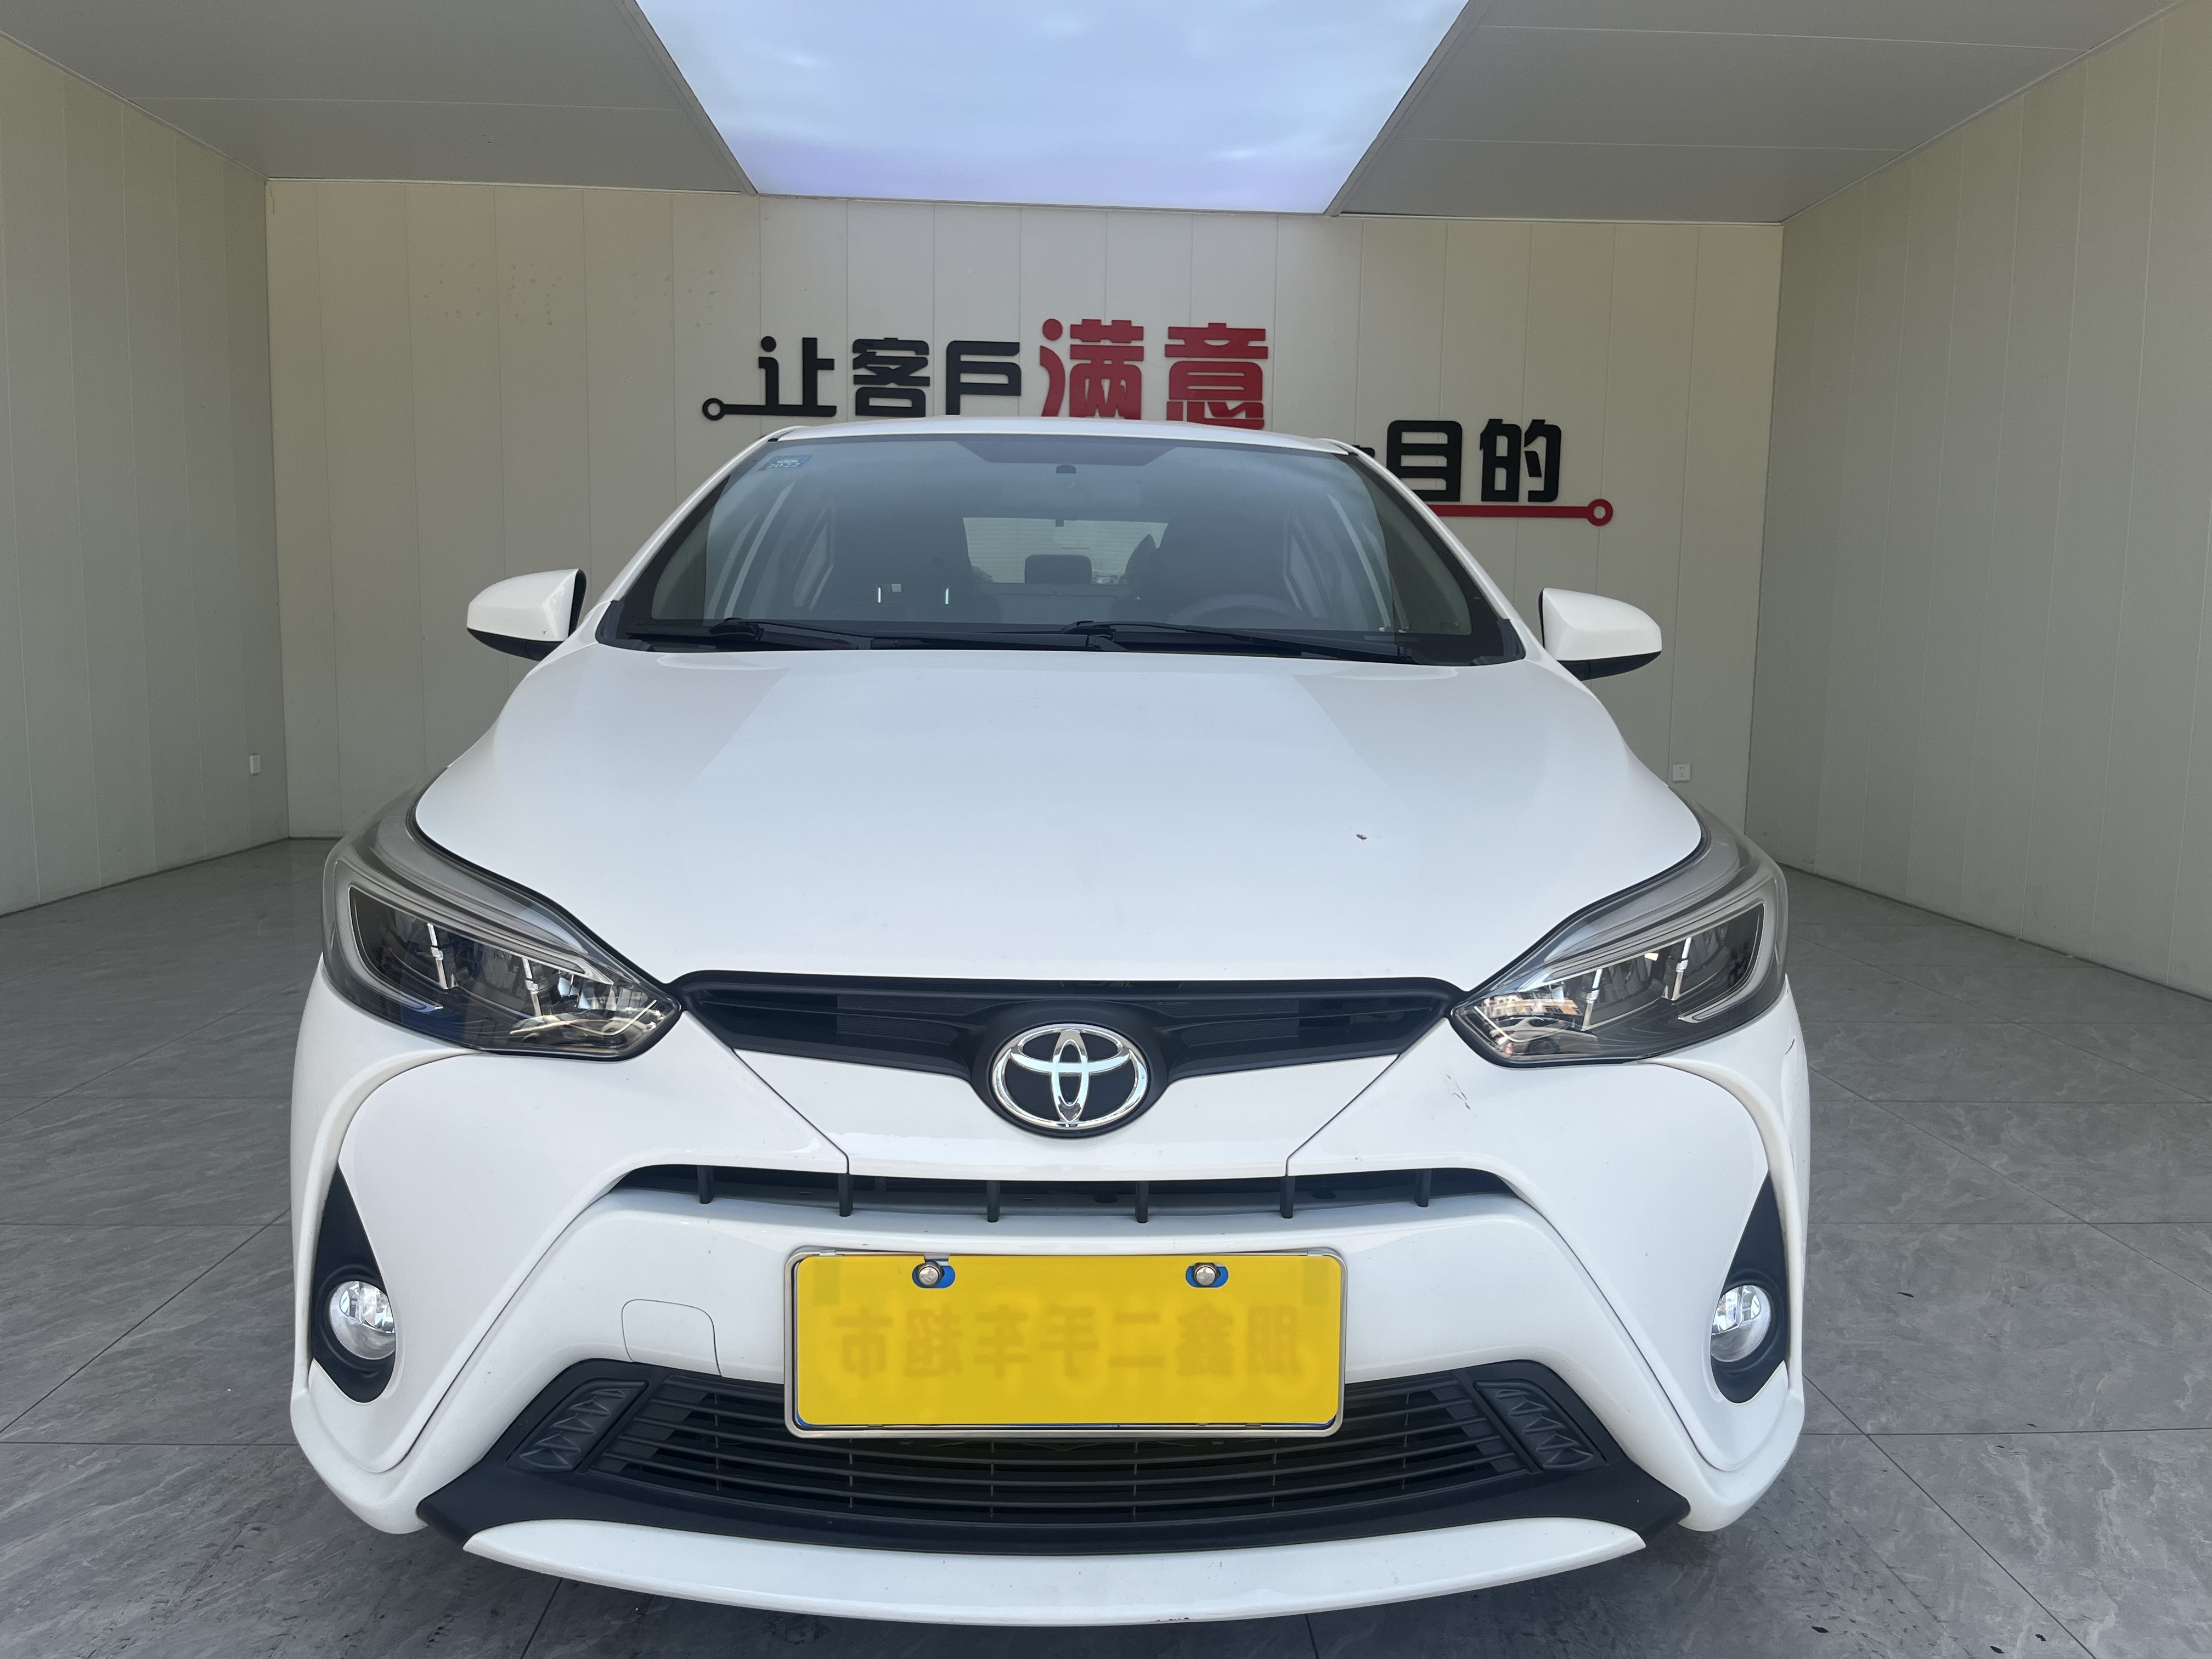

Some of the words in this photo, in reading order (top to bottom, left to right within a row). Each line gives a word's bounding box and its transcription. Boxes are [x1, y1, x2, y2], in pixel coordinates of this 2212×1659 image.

[758, 318, 1268, 431] 让客户满意
[1352, 419, 1562, 503] 目的
